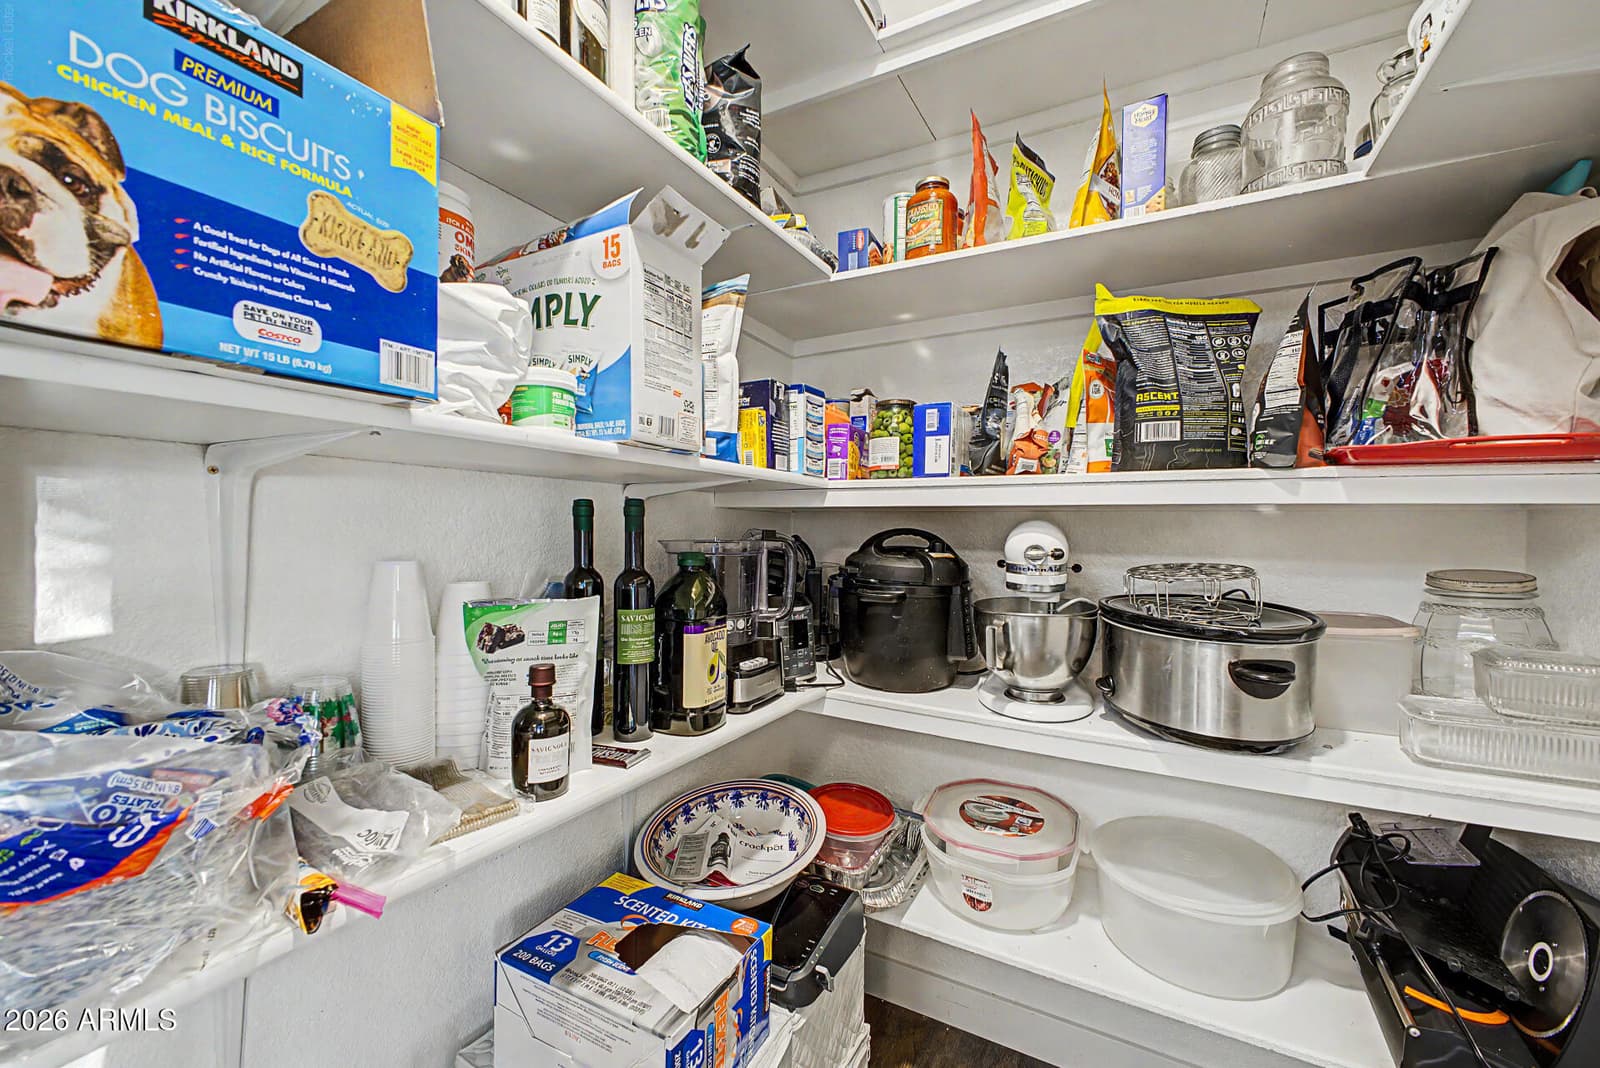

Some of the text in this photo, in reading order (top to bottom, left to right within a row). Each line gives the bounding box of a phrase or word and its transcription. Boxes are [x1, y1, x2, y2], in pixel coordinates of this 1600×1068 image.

[153, 0, 299, 80] KIRKLAND
[152, 12, 299, 92] Signature
[182, 57, 273, 112] PREMIUM
[69, 30, 351, 181] DOG BISCUITS
[57, 65, 353, 199] CHICKEN MEAL & RICE FORMULA
[193, 222, 201, 231] A
[203, 225, 227, 239] Good
[261, 244, 281, 257] Dogs
[603, 233, 621, 260] 15
[193, 251, 208, 263] No
[602, 259, 621, 269] BAGS
[243, 304, 313, 327] SAVE ON YOUR
[243, 311, 260, 320] PET
[281, 320, 313, 333] NEEDS
[258, 328, 302, 344] COSTCO
[219, 342, 240, 355] NET
[243, 345, 260, 360] WT
[263, 350, 275, 362] 15
[276, 354, 290, 365] LB
[568, 354, 593, 367] SIMPLY
[1136, 391, 1179, 402] ASCENT
[1009, 563, 1062, 573] KitchenAid
[112, 794, 161, 809] PLATES
[614, 896, 680, 924] SCENTED
[543, 934, 572, 953] 13
[513, 949, 556, 972] 200 BAGS
[749, 948, 758, 1006] SCENTED
